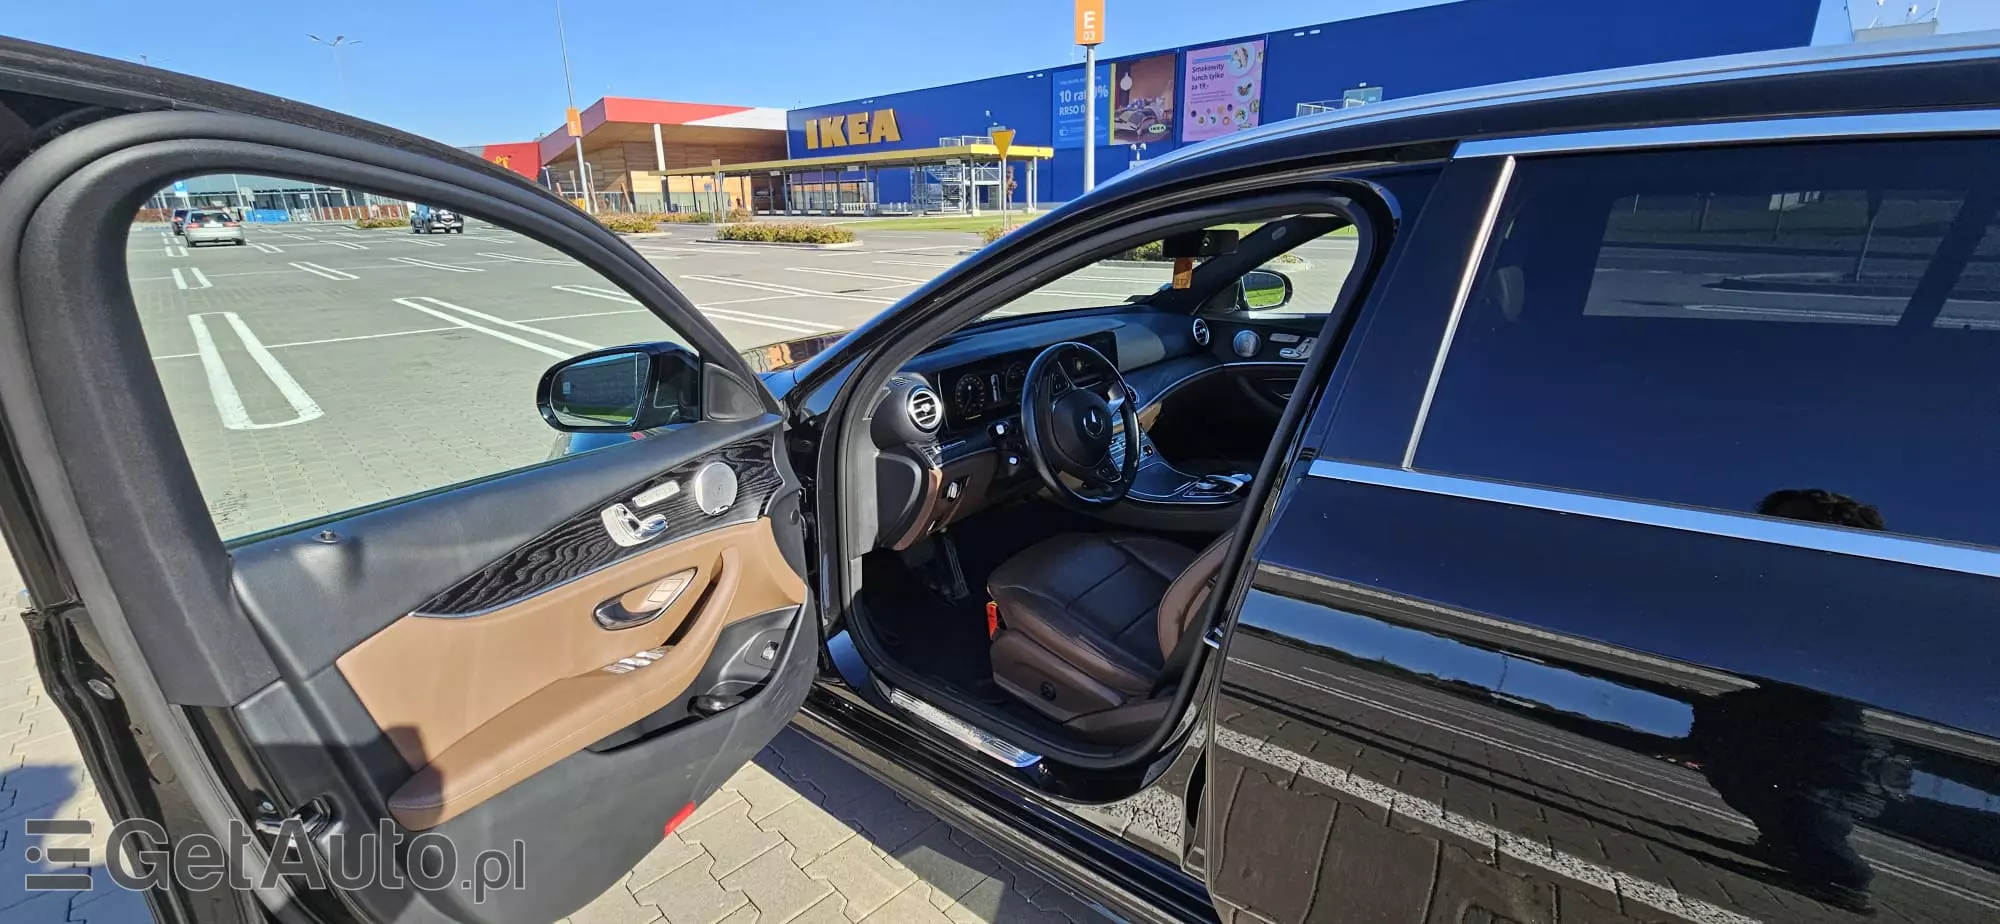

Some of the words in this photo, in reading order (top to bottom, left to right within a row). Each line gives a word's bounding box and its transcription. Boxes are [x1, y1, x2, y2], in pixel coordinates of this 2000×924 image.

[1083, 11, 1096, 29] E
[1191, 63, 1225, 73] Smakowity
[1191, 74, 1208, 82] lunch
[1059, 90, 1071, 103] 10
[805, 108, 902, 150] IKEA
